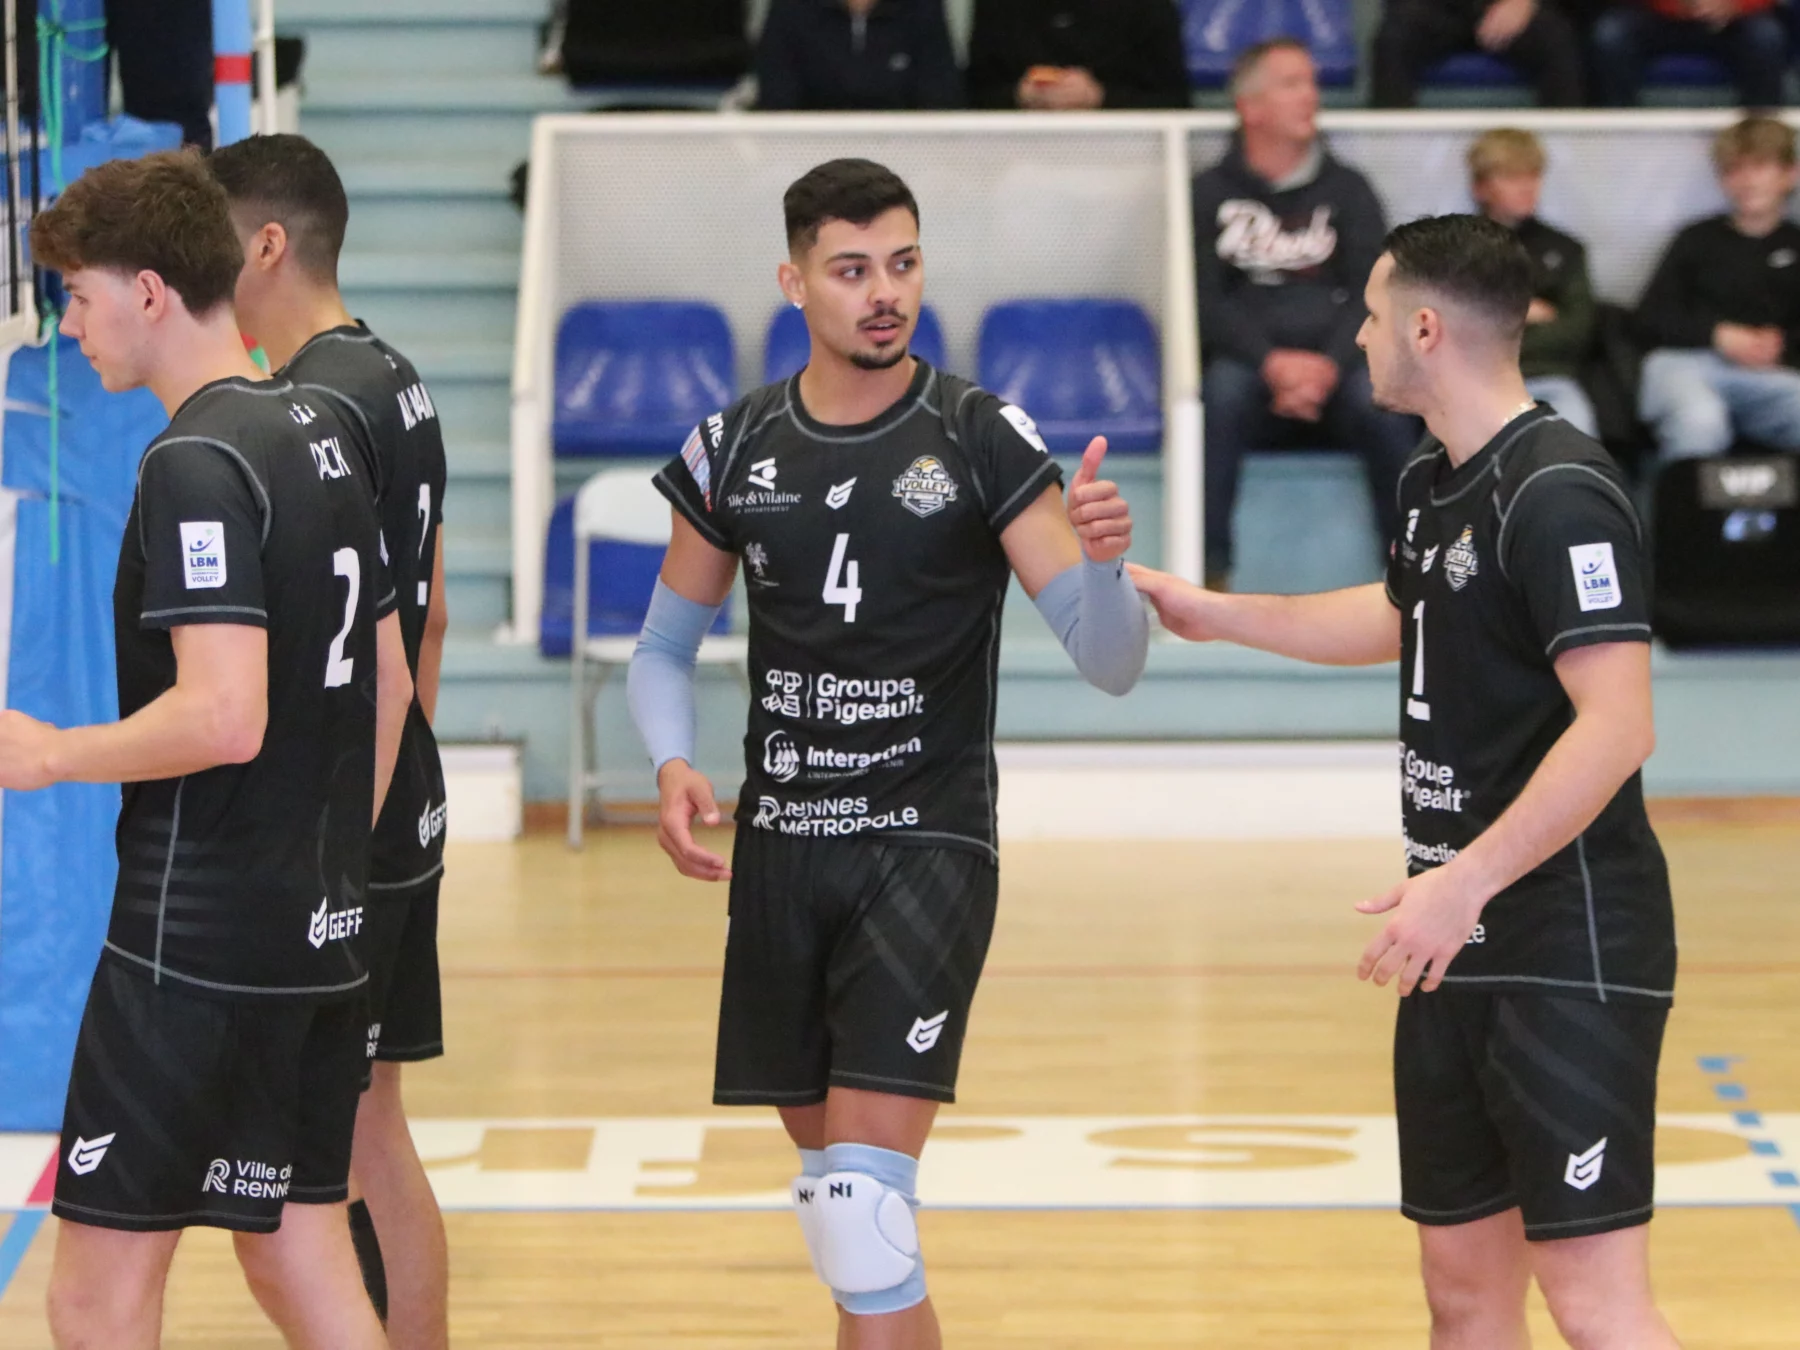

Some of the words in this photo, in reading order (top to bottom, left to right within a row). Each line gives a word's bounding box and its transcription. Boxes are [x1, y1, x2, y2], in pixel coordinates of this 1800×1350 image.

[745, 490, 757, 505] &
[758, 491, 802, 504] Vilaine
[903, 480, 947, 492] VOLLEY
[189, 556, 218, 568] LBM
[822, 533, 862, 622] 4
[1583, 577, 1611, 590] LBM
[324, 547, 360, 688] 2
[1406, 600, 1430, 721] 1
[817, 673, 916, 703] Groupe
[816, 694, 925, 725] Pigeault
[328, 906, 363, 940] GEFF
[237, 1160, 277, 1180] Ville
[829, 1182, 852, 1199] N1
